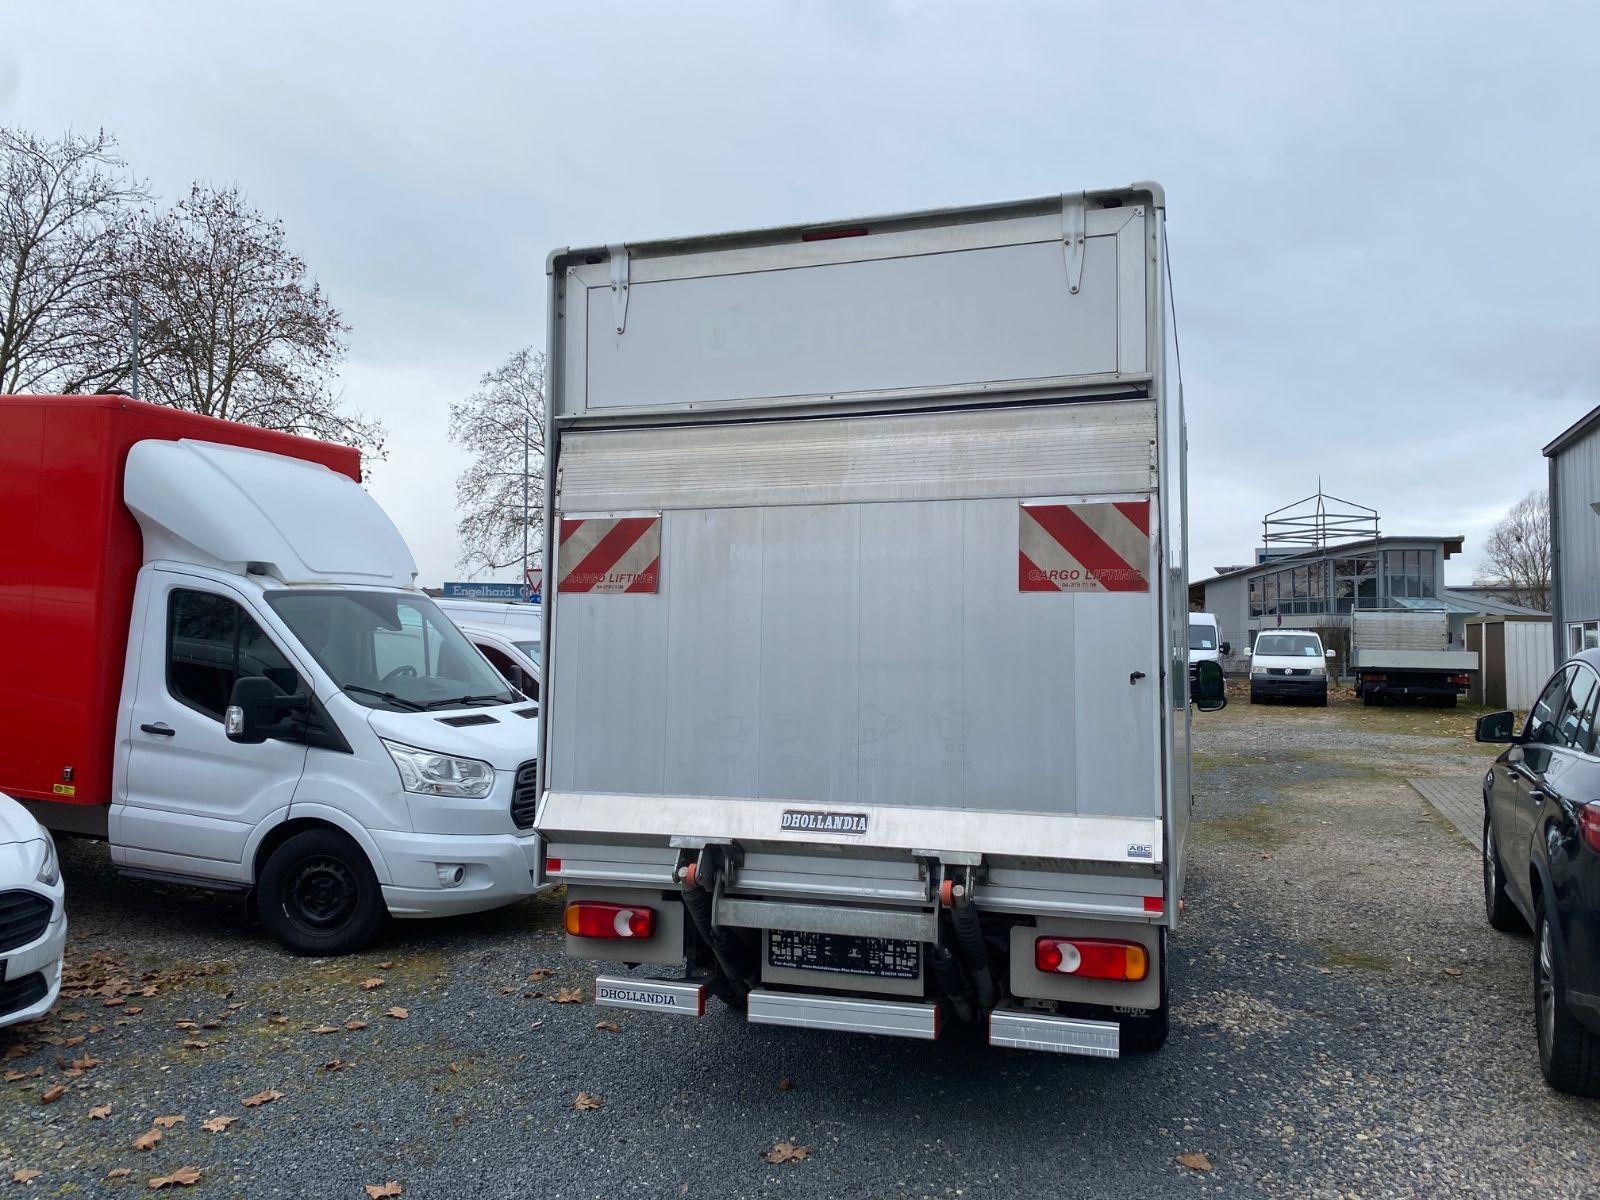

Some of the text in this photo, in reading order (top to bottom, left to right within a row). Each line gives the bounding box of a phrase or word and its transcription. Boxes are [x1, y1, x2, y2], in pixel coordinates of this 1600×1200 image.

[565, 572, 653, 584] CARGO LIFTING
[1028, 568, 1142, 581] CARGO LIFTING
[452, 585, 515, 598] Engelhardt
[781, 813, 867, 831] DHOLLANDIA
[600, 988, 676, 1006] DHOLLANDIA
